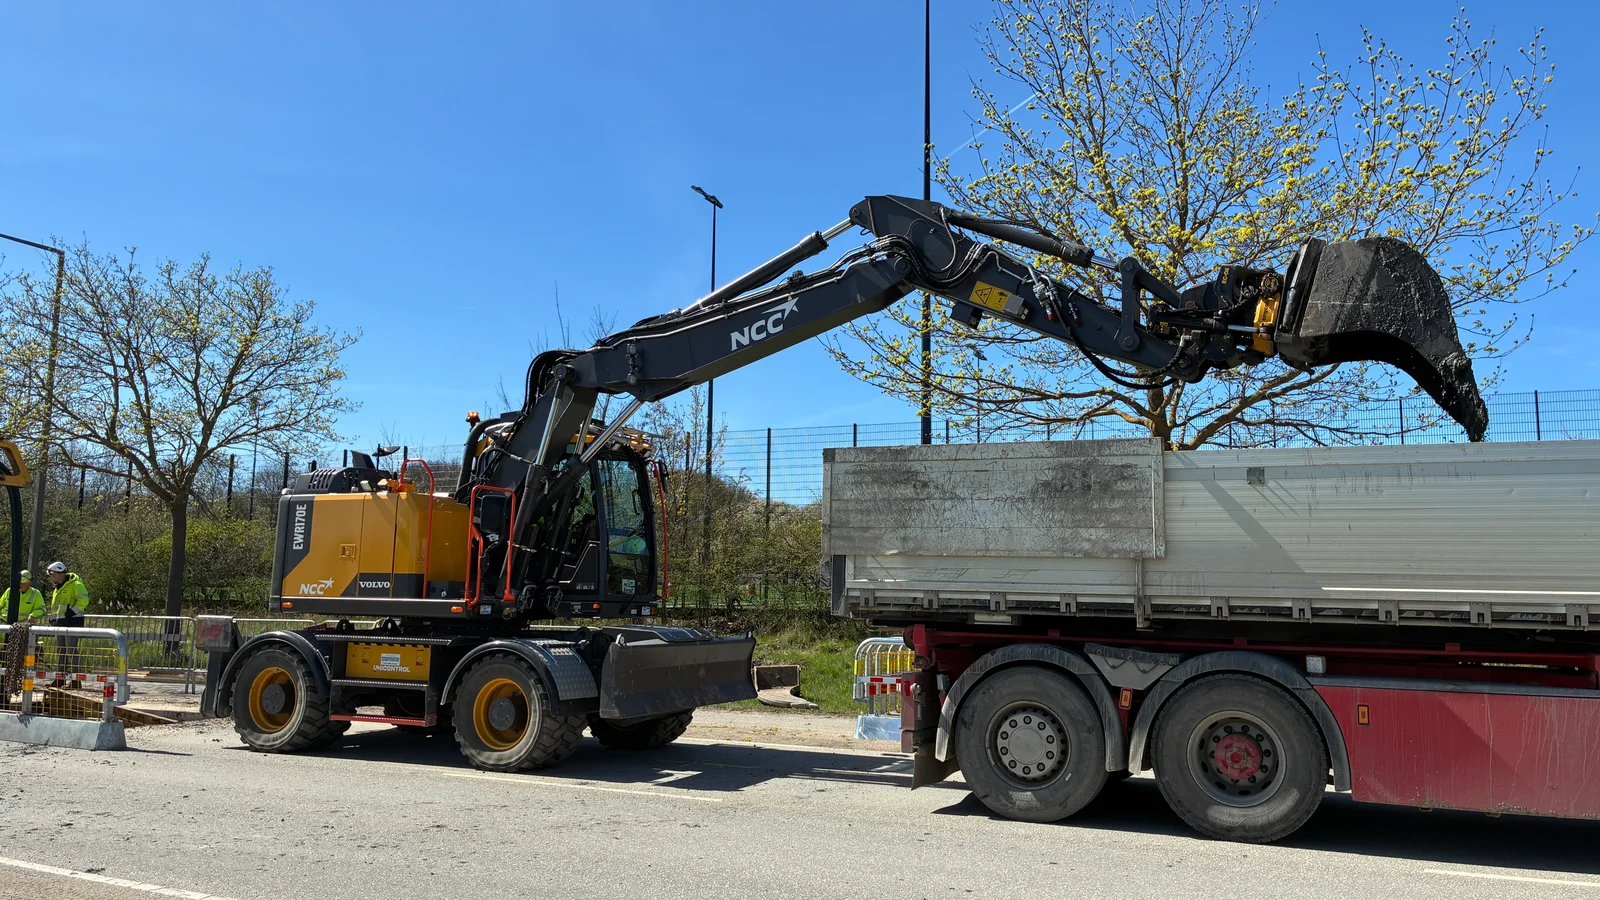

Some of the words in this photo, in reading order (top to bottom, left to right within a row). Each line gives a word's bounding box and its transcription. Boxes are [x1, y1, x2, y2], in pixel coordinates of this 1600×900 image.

[729, 312, 784, 351] NCC
[292, 503, 307, 550] EWR170E
[299, 583, 326, 595] NCC
[359, 581, 391, 589] VOLVO
[373, 665, 410, 673] UNICONTROL
